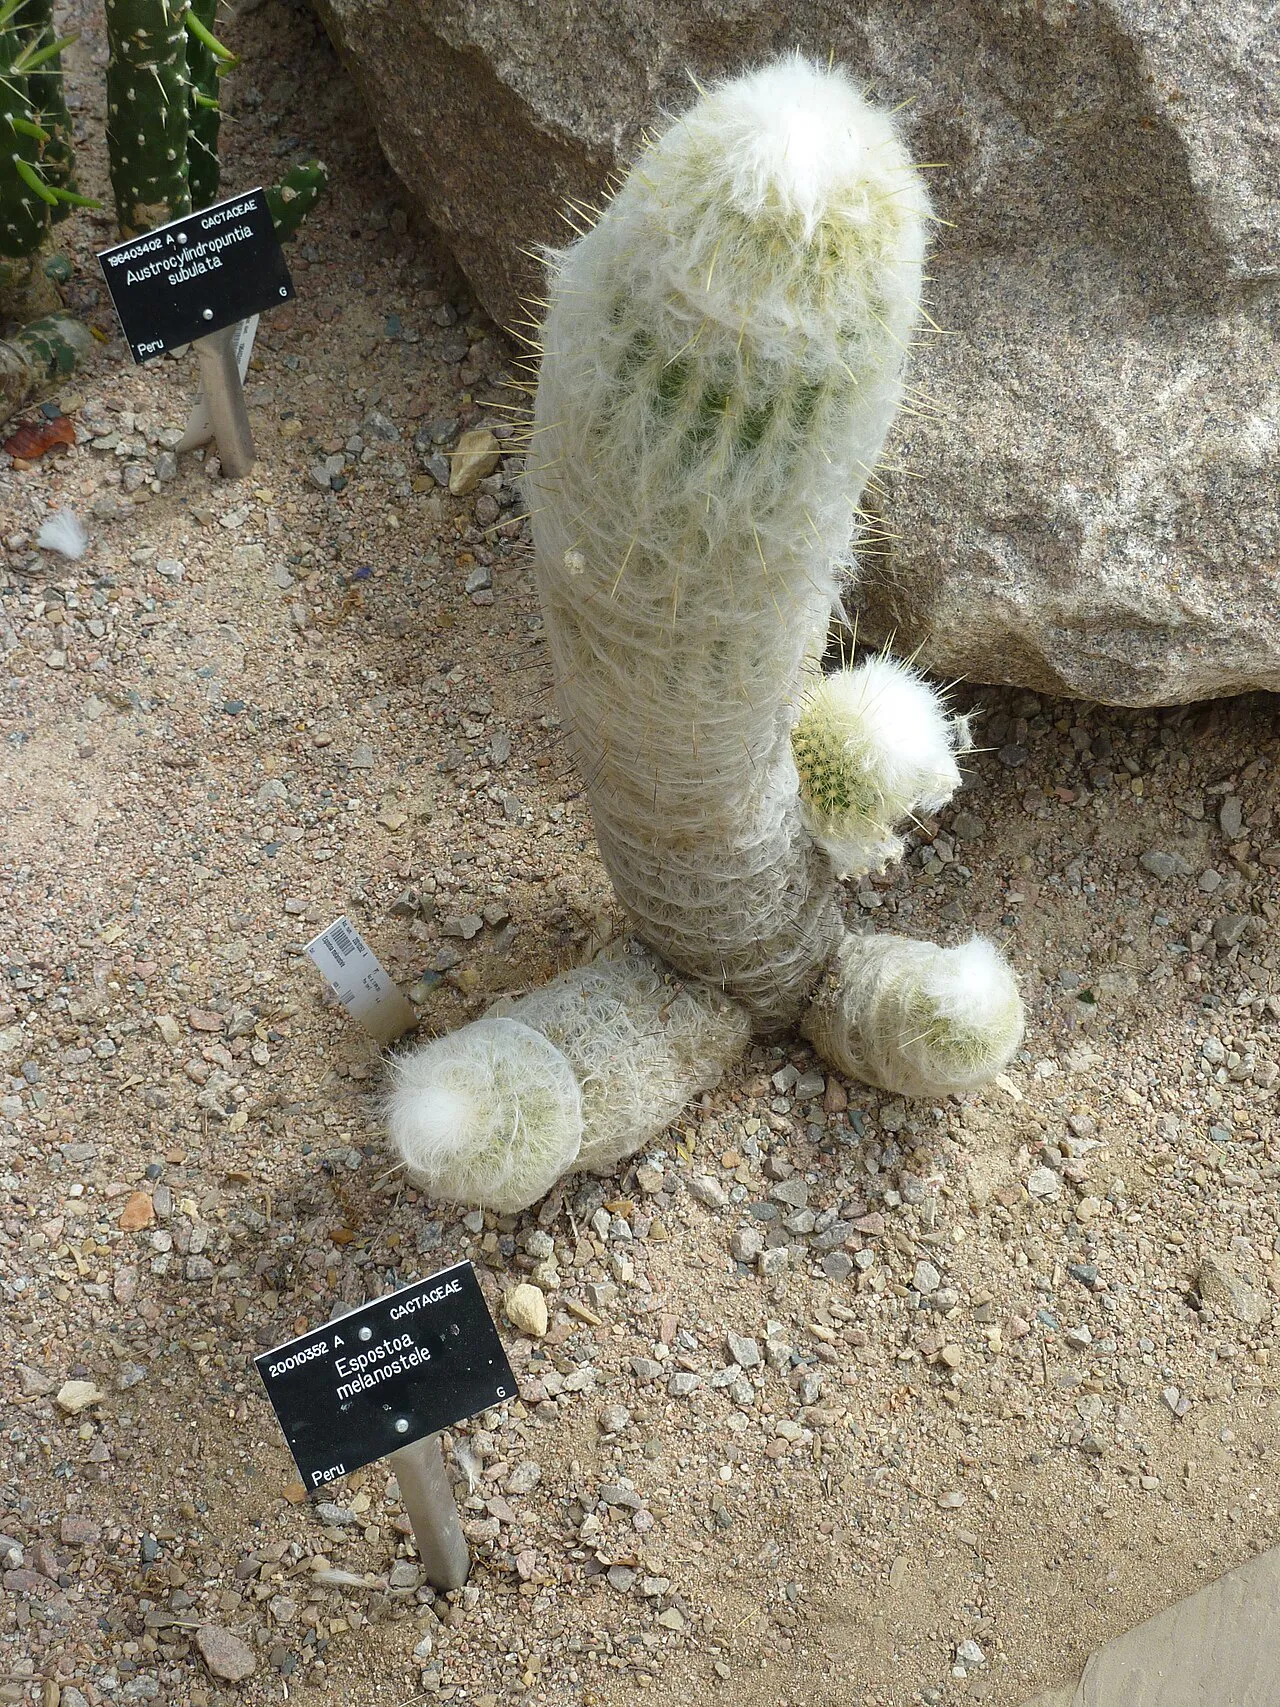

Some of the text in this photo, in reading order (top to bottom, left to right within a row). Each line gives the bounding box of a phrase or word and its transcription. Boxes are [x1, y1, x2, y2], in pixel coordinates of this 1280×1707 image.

[201, 200, 258, 230] CACTACEAE
[108, 234, 175, 267] 196403402 A
[126, 225, 253, 286] Austrocylindropuntia
[168, 256, 223, 286] subulata
[279, 286, 288, 297] G
[137, 339, 164, 356] Peru
[390, 1279, 463, 1321] CACTACEAE
[268, 1335, 345, 1378] 20010352 A
[335, 1333, 414, 1378] Espostoa
[336, 1345, 432, 1400] melanostele
[496, 1386, 506, 1398] G
[311, 1463, 346, 1487] Peru
